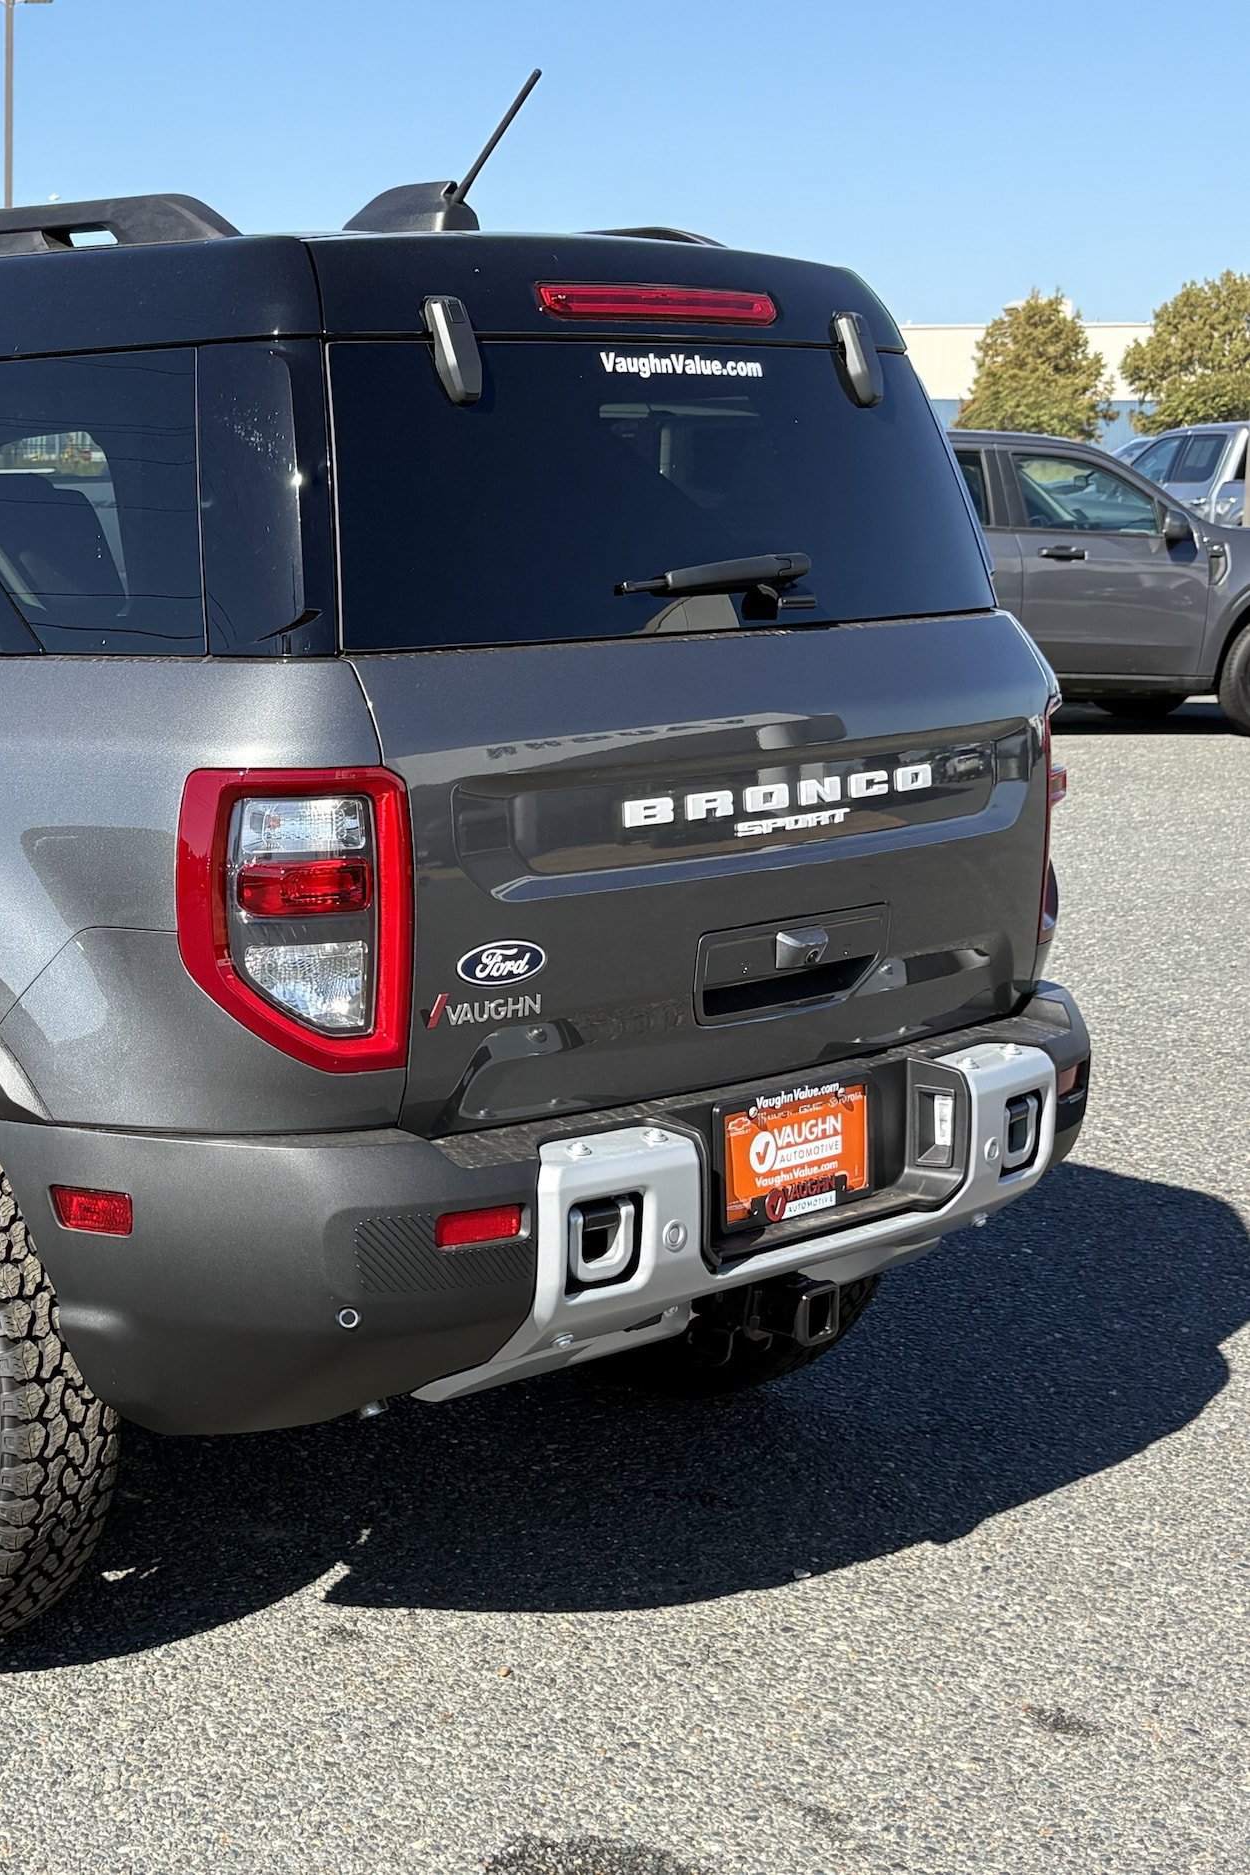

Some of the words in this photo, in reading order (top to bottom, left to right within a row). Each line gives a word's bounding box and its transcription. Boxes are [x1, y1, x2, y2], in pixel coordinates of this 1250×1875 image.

[600, 352, 763, 378] VaughnValue.com
[622, 764, 932, 828] BRONCO
[734, 807, 851, 838] SPORT
[475, 948, 531, 978] Ford
[445, 993, 541, 1026] VAUGHN
[756, 1082, 839, 1109] VaughnValue.com
[773, 1112, 842, 1147] VAUGHN
[779, 1140, 839, 1163] AUTOMOTIVE
[755, 1161, 839, 1188] VaughnValue.com
[783, 1174, 836, 1201] VAUGHN
[788, 1195, 834, 1213] AUTOMOTIVE
